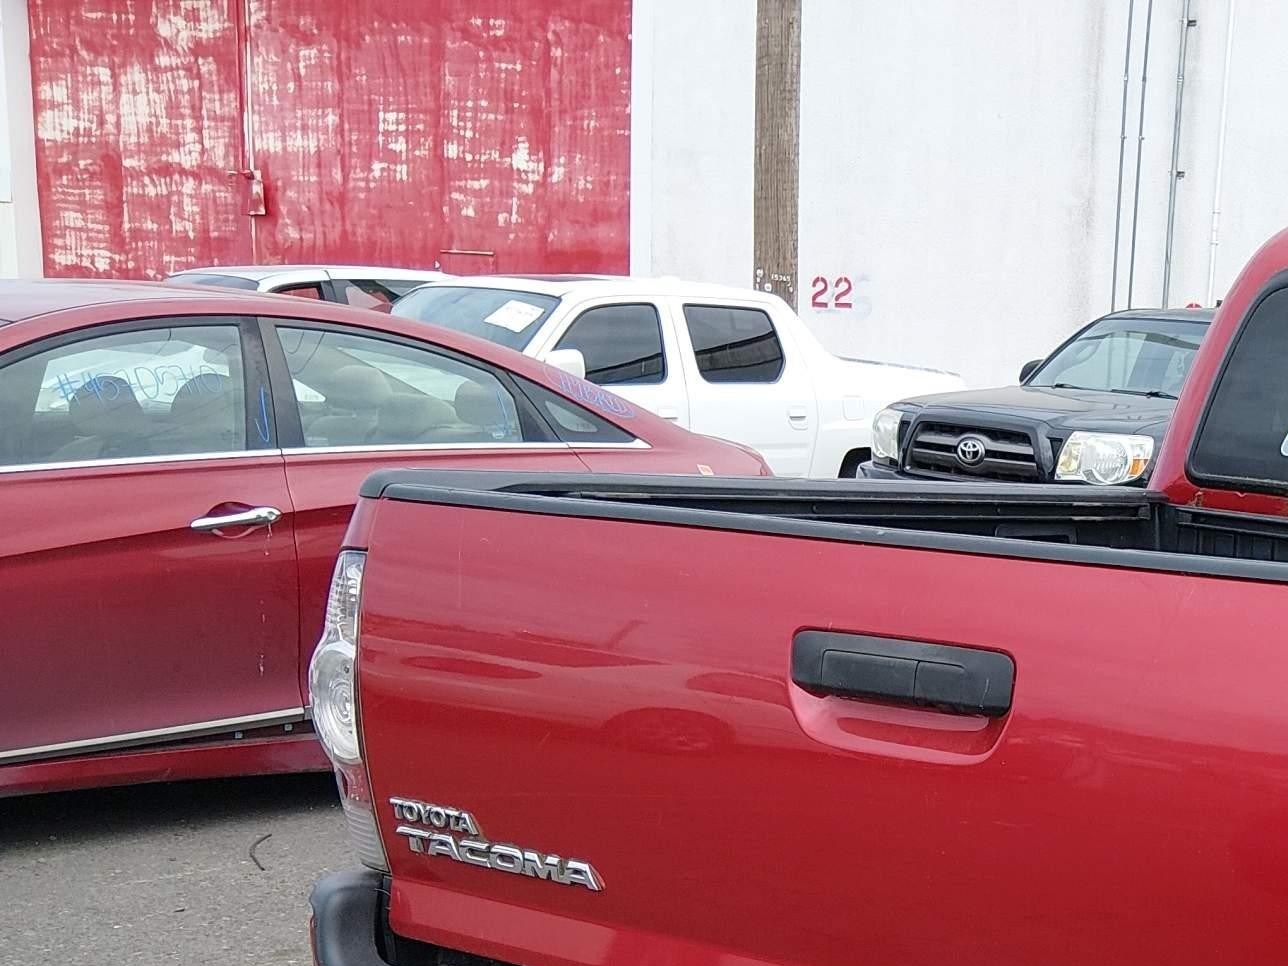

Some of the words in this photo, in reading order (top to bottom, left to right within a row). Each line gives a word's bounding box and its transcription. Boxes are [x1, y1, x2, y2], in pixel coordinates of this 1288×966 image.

[811, 276, 853, 308] 22
[389, 796, 479, 836] TOYOTA
[396, 825, 605, 892] TACOMA
